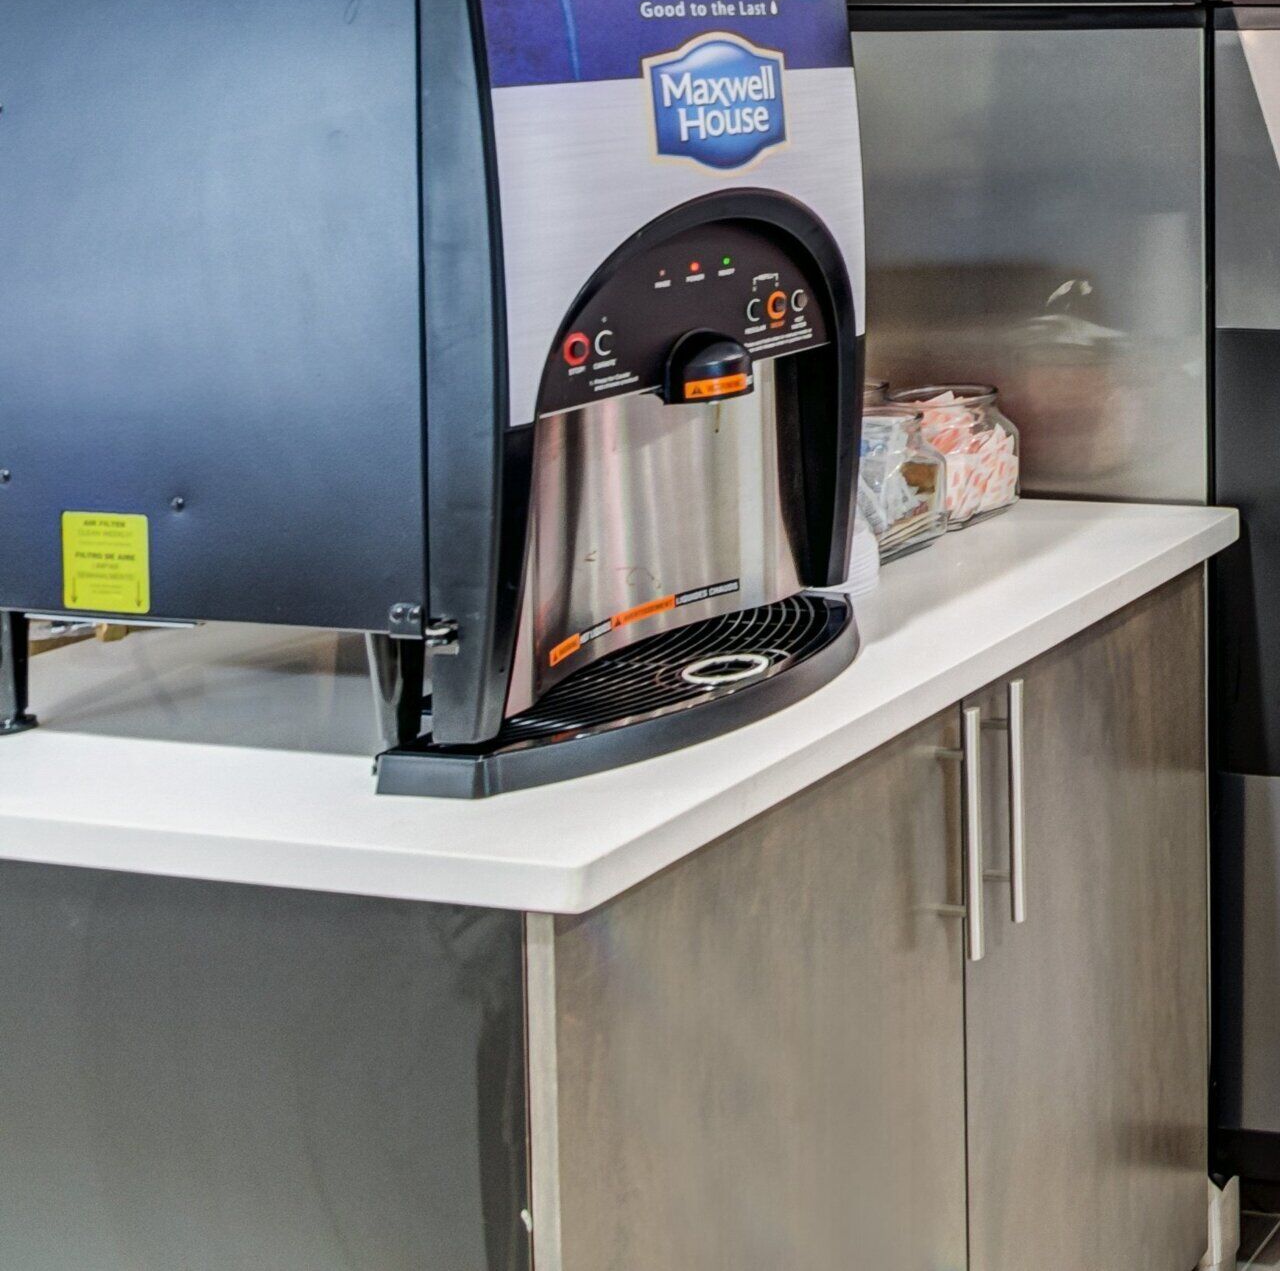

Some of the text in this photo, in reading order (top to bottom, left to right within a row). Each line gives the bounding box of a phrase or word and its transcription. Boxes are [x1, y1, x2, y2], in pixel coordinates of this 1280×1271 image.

[640, 0, 767, 17] Good to the Last
[660, 65, 775, 107] Maxwell
[678, 106, 770, 141] House
